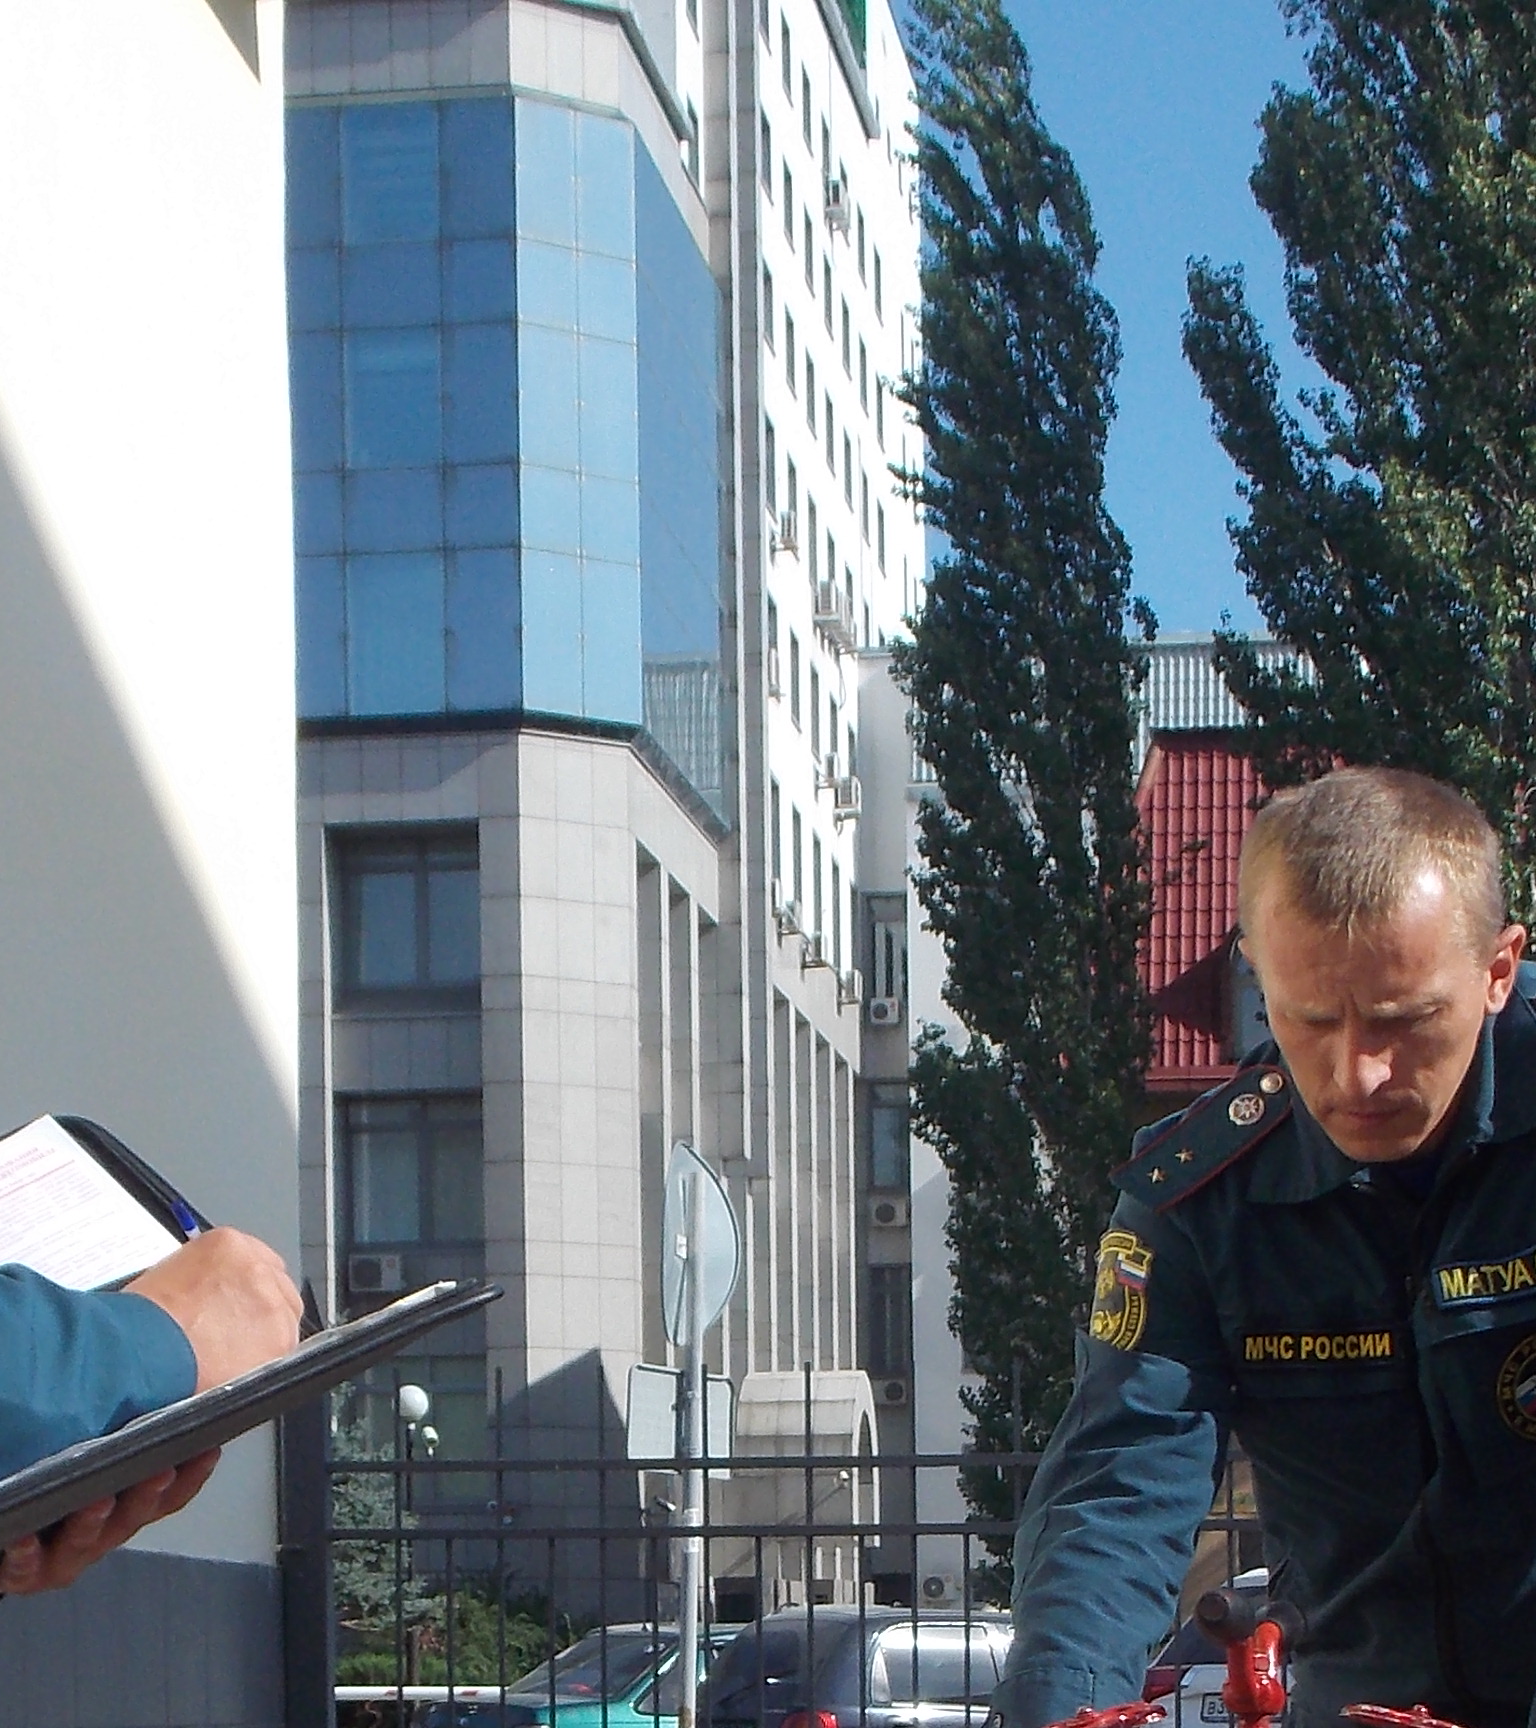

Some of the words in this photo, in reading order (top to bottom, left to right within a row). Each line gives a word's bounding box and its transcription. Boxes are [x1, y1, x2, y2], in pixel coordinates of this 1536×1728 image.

[1439, 1258, 1534, 1300] МАТУА
[1245, 1335, 1294, 1360] МЧС
[1300, 1333, 1391, 1360] РОССИИ
